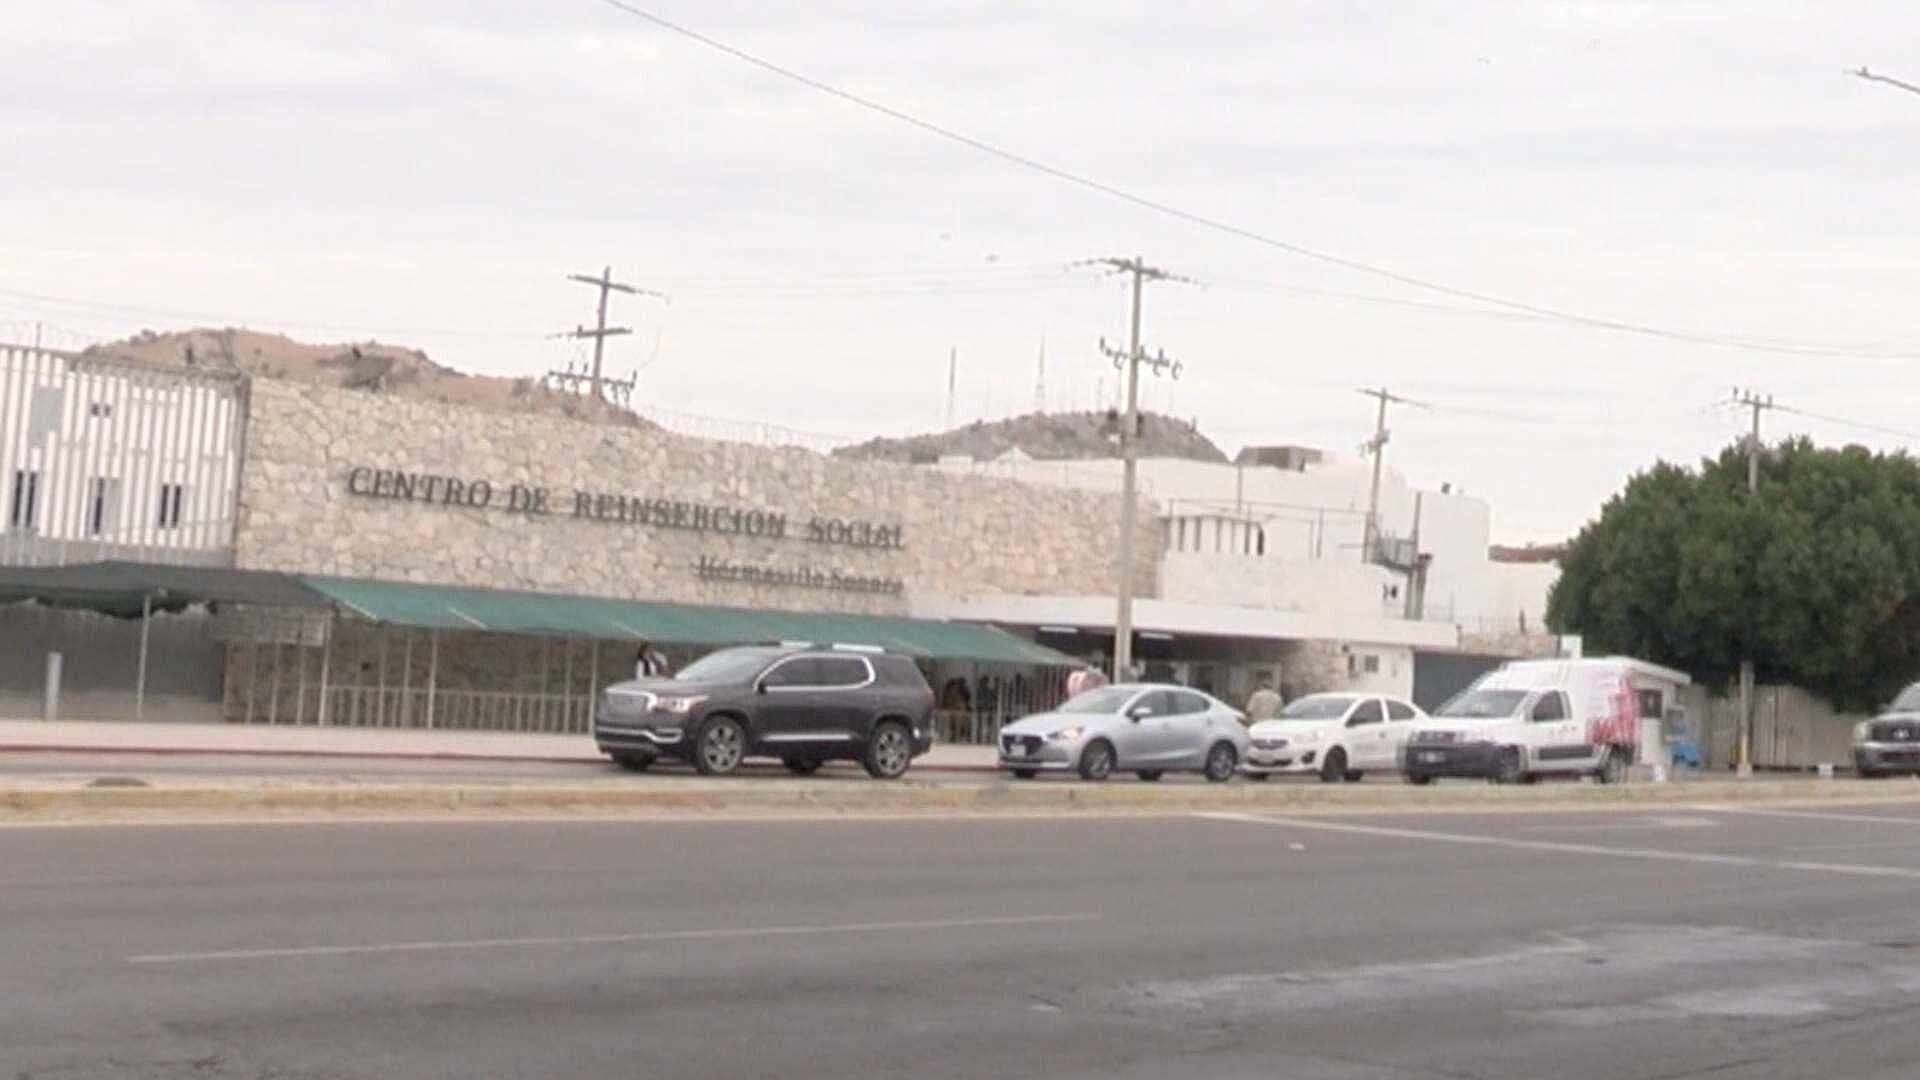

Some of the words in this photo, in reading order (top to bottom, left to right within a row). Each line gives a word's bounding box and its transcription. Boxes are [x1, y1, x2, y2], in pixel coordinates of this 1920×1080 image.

[348, 465, 492, 508] CENTRO
[506, 484, 550, 514] DE
[573, 488, 786, 539] REINSERCION
[808, 516, 903, 550] SOCIAL
